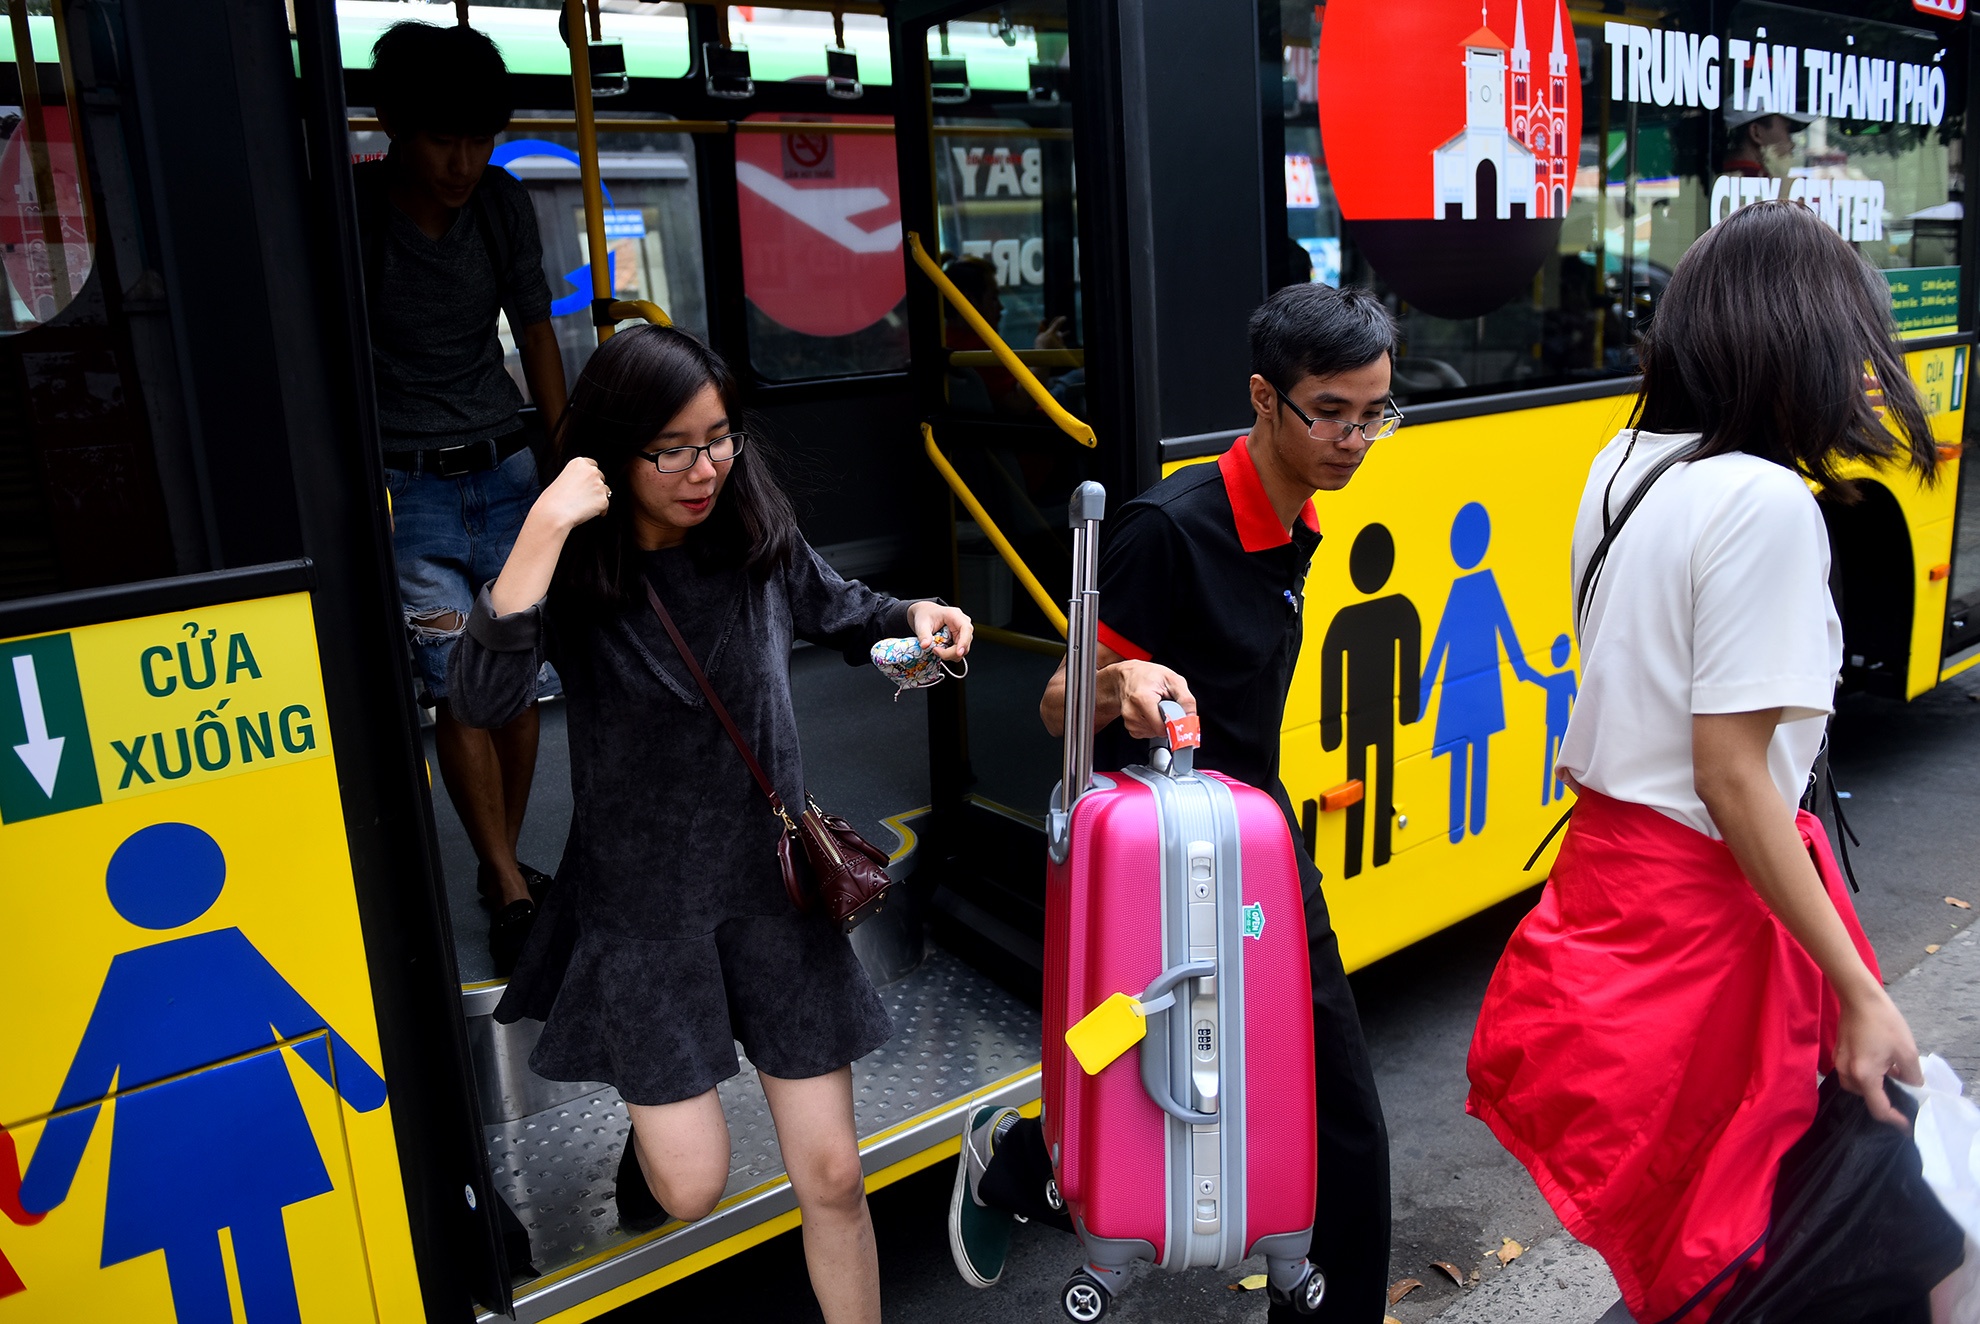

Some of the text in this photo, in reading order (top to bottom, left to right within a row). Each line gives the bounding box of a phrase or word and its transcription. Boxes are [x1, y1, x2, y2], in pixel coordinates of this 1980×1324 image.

[1604, 21, 1947, 127] TRUNG TÂM THÀNH PHỐ
[1927, 354, 1944, 383] CỬA
[140, 621, 263, 698] CỬA
[109, 697, 316, 791] XUỐNG
[1251, 911, 1261, 931] OPEN
